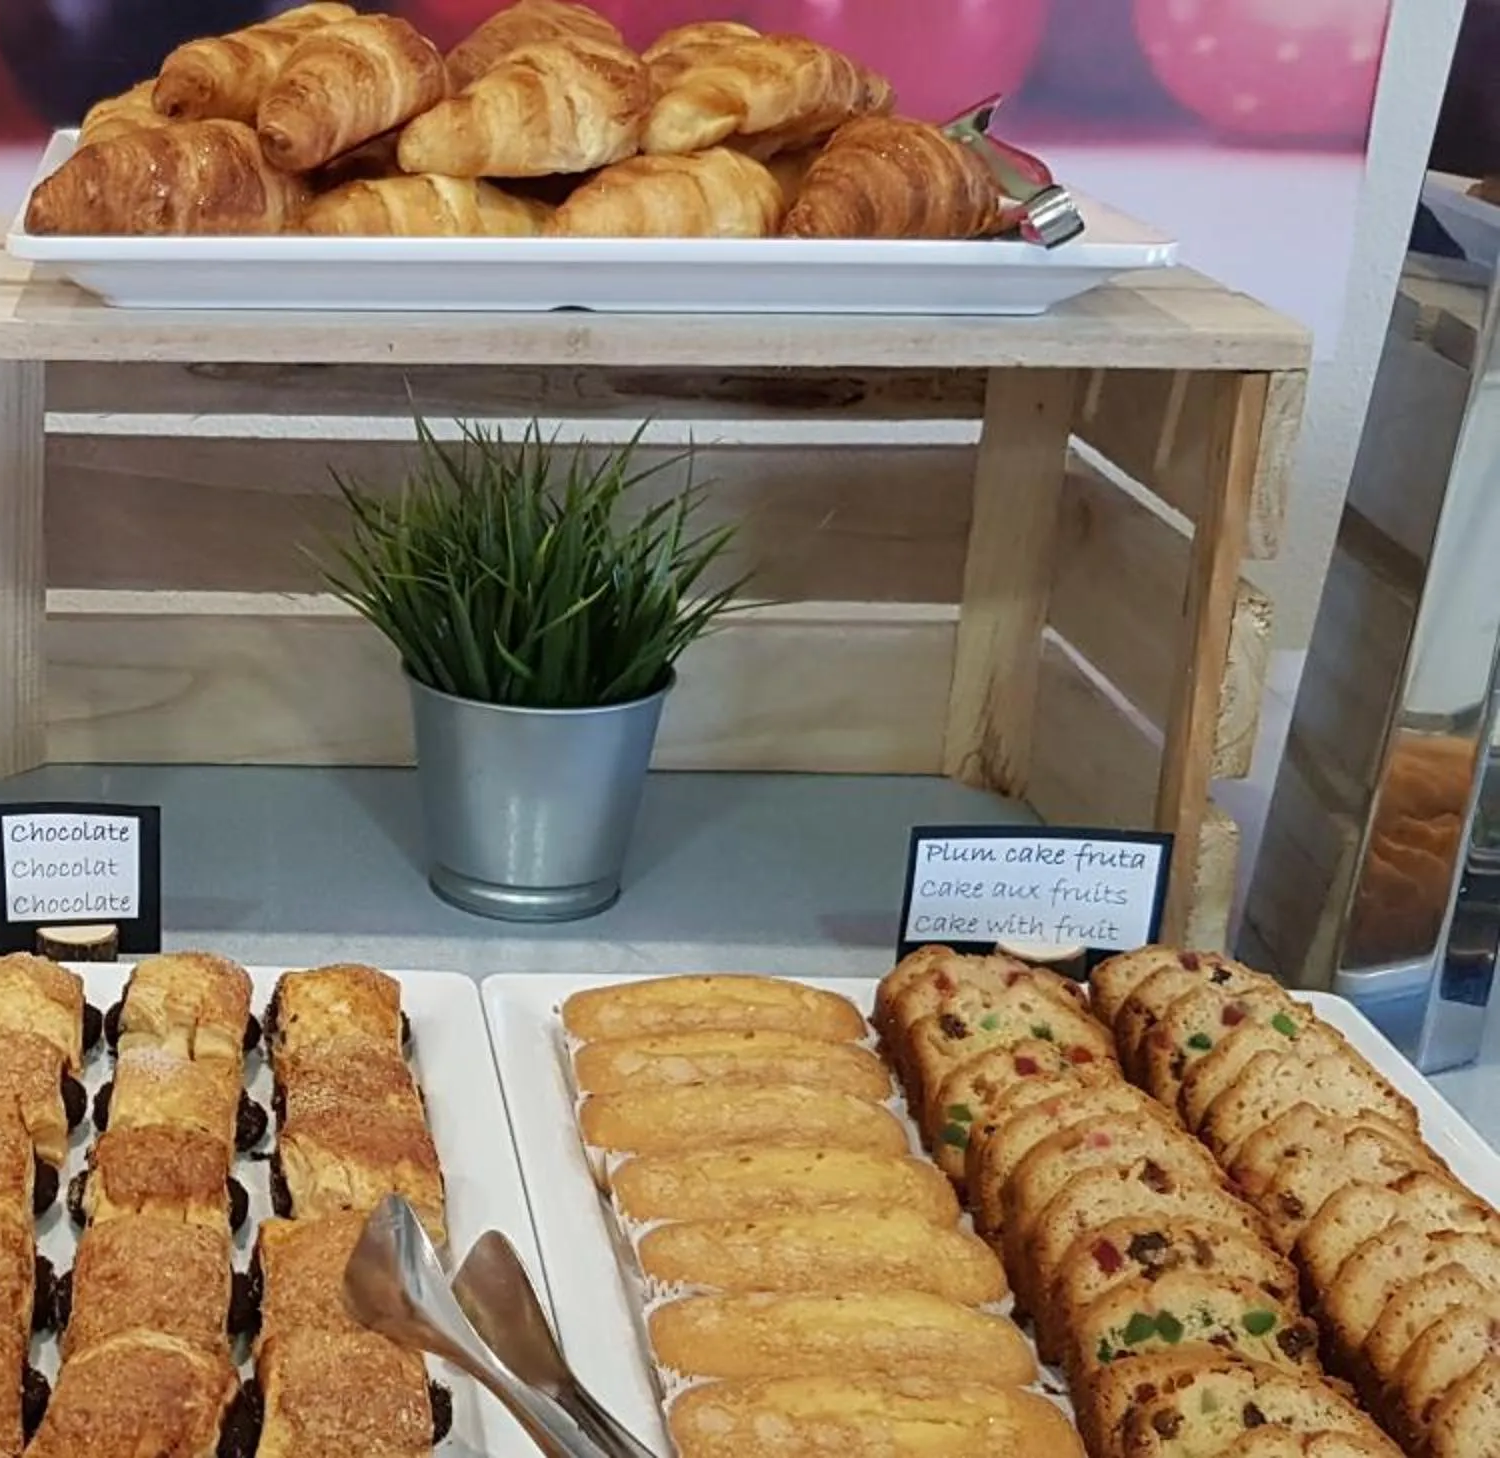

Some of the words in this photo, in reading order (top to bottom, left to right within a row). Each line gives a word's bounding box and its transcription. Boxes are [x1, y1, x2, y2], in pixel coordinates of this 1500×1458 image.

[11, 821, 130, 842] Chocolate
[11, 857, 118, 878] Chocolat
[925, 843, 997, 862] Plum
[1005, 843, 1066, 865] cake
[1073, 843, 1146, 872] fruta
[13, 892, 131, 914] Chocolate
[991, 883, 1041, 899] aux
[1049, 878, 1129, 906] fruits
[987, 913, 1045, 936] with
[1054, 915, 1119, 943] fruit
